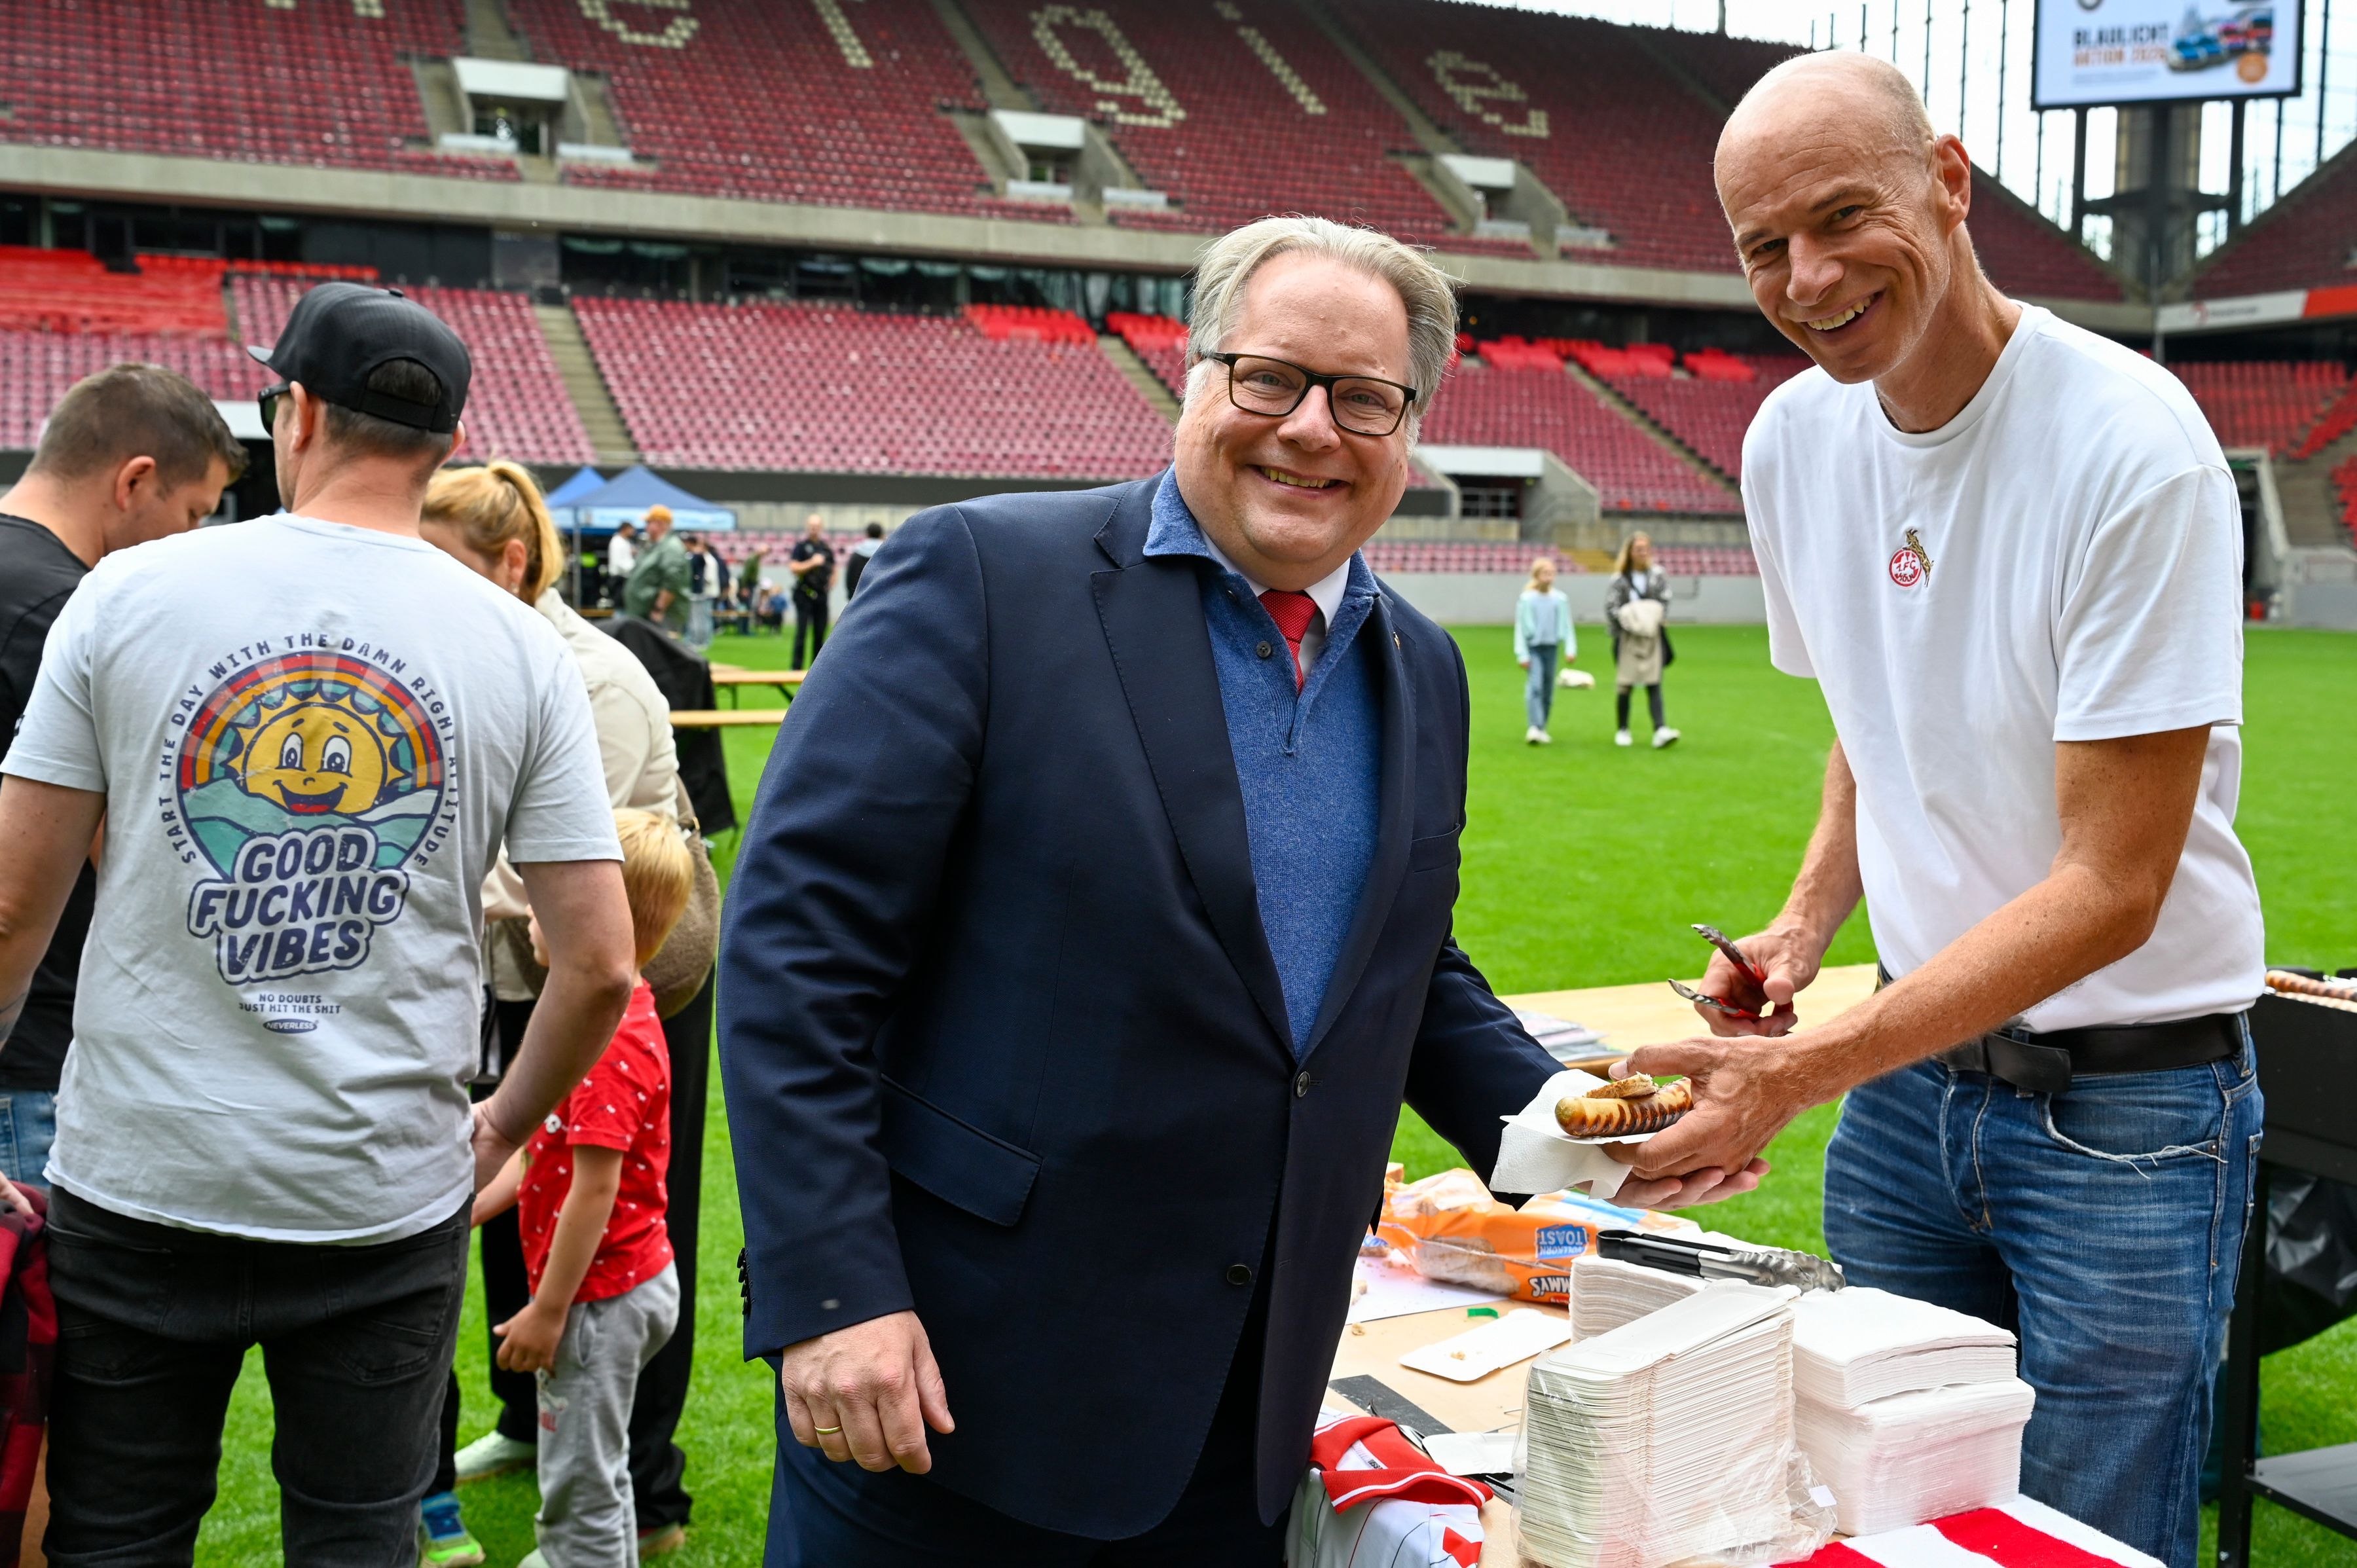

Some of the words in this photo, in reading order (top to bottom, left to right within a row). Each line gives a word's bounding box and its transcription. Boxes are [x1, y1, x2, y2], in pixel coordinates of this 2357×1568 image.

[208, 640, 271, 680] WITH
[284, 632, 327, 649] THE
[341, 636, 407, 674] DAMN
[171, 684, 204, 727] DAY
[411, 676, 456, 742] RIGHT
[159, 738, 175, 781] THE
[158, 796, 196, 864] START
[413, 756, 459, 867] ATTITUDE
[242, 833, 369, 883] GOOD
[196, 875, 400, 929] FUCKING
[227, 920, 364, 975] VIBES
[239, 1002, 265, 1012] JUST
[269, 1003, 288, 1013] HIT
[292, 1004, 311, 1013] THE
[314, 1005, 341, 1014] SHIT
[259, 993, 274, 1002] NO
[278, 994, 322, 1004] DOUBTS
[266, 1021, 315, 1030] NEVERLESS
[1539, 1231, 1582, 1245] TOAST
[1529, 1277, 1570, 1297] MMY'S
